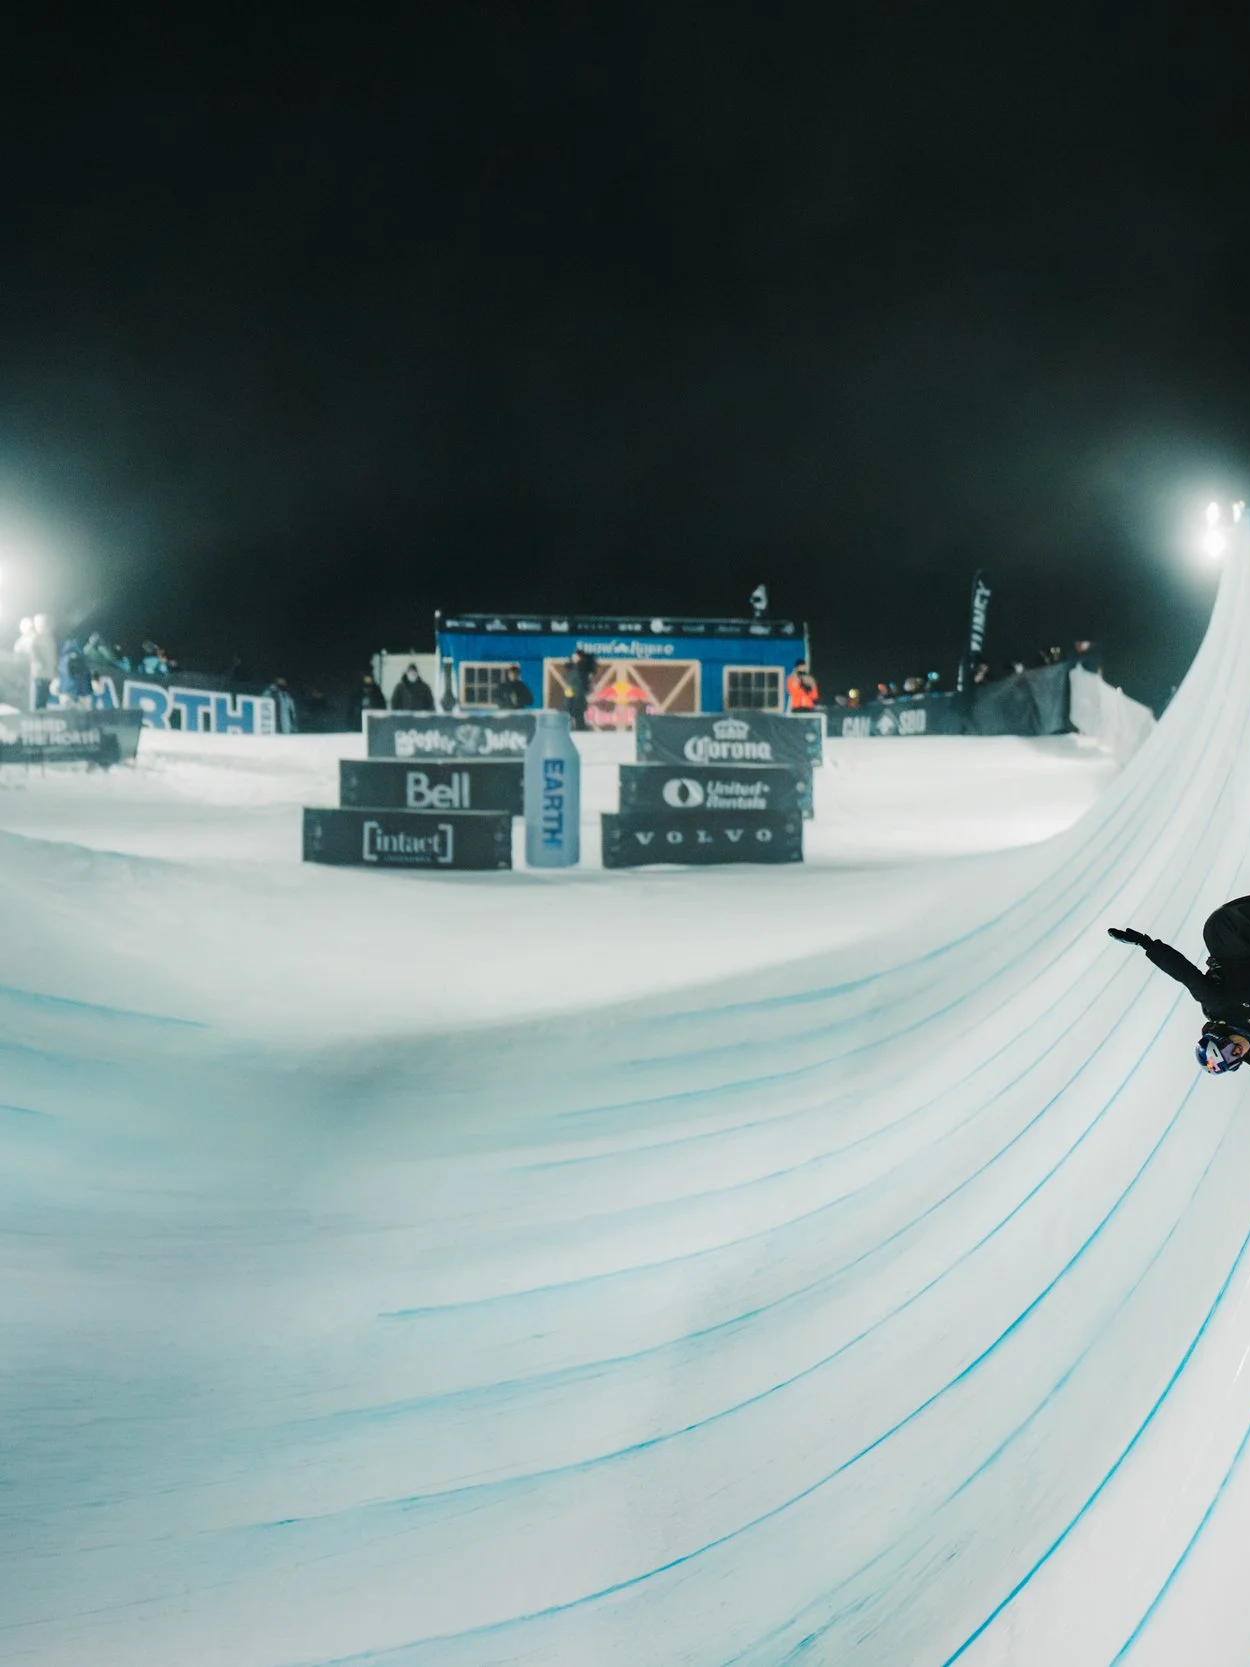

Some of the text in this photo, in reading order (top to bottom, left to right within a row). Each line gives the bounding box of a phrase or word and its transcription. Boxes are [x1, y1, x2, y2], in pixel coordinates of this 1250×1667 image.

[684, 735, 773, 763] Corona
[406, 771, 470, 809] Bell
[541, 758, 566, 849] EARTH
[634, 828, 773, 846] VOLVO
